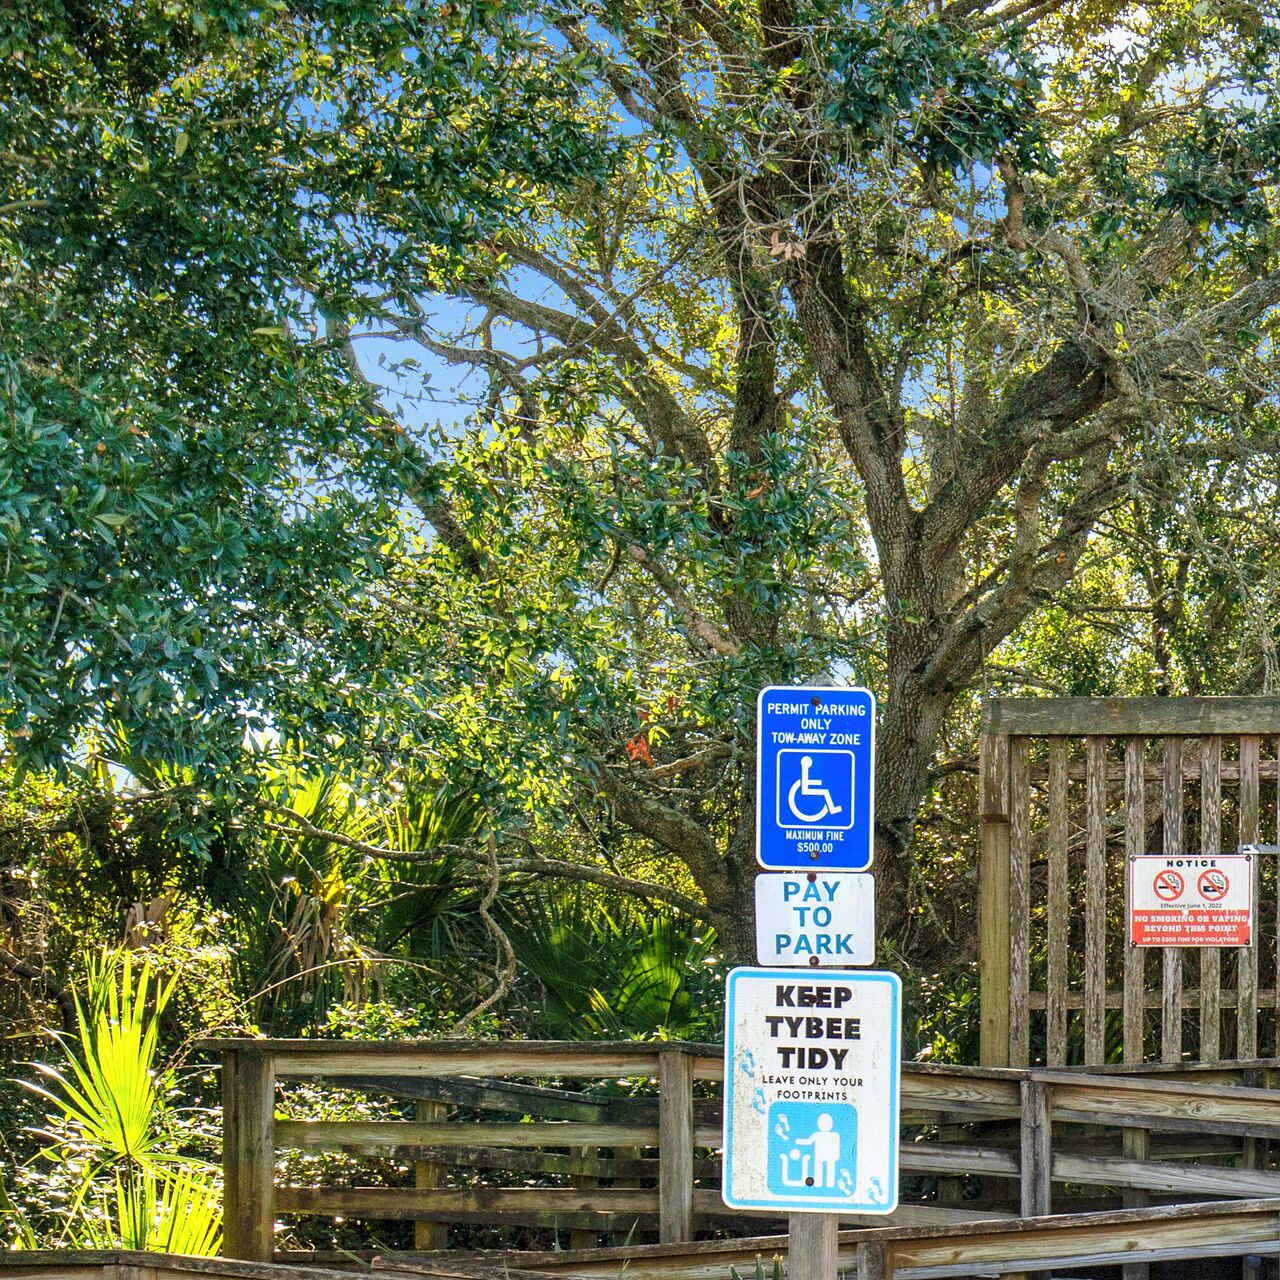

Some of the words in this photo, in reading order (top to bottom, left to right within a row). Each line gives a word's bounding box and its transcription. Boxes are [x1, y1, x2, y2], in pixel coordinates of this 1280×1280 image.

[767, 703, 808, 715] PERMIT
[815, 705, 866, 716] PARKING
[801, 719, 831, 730] ONLY
[771, 732, 825, 744] TOW-AWAY
[830, 733, 860, 745] ZONE
[786, 830, 823, 840] MAXIMUM
[826, 831, 844, 840] FINE
[797, 843, 833, 853] $500.00
[784, 881, 840, 902] PAY
[793, 907, 831, 927] TO
[1184, 925, 1206, 933] THIS
[775, 934, 854, 955] PARK
[776, 985, 852, 1008] KEEP
[765, 1016, 861, 1040] TYBEE
[777, 1048, 849, 1070] TIDY
[763, 1075, 795, 1085] LEAVE
[800, 1077, 828, 1086] ONLY
[833, 1078, 863, 1087] YOUR
[777, 1091, 847, 1101] FOOTPRINTS
